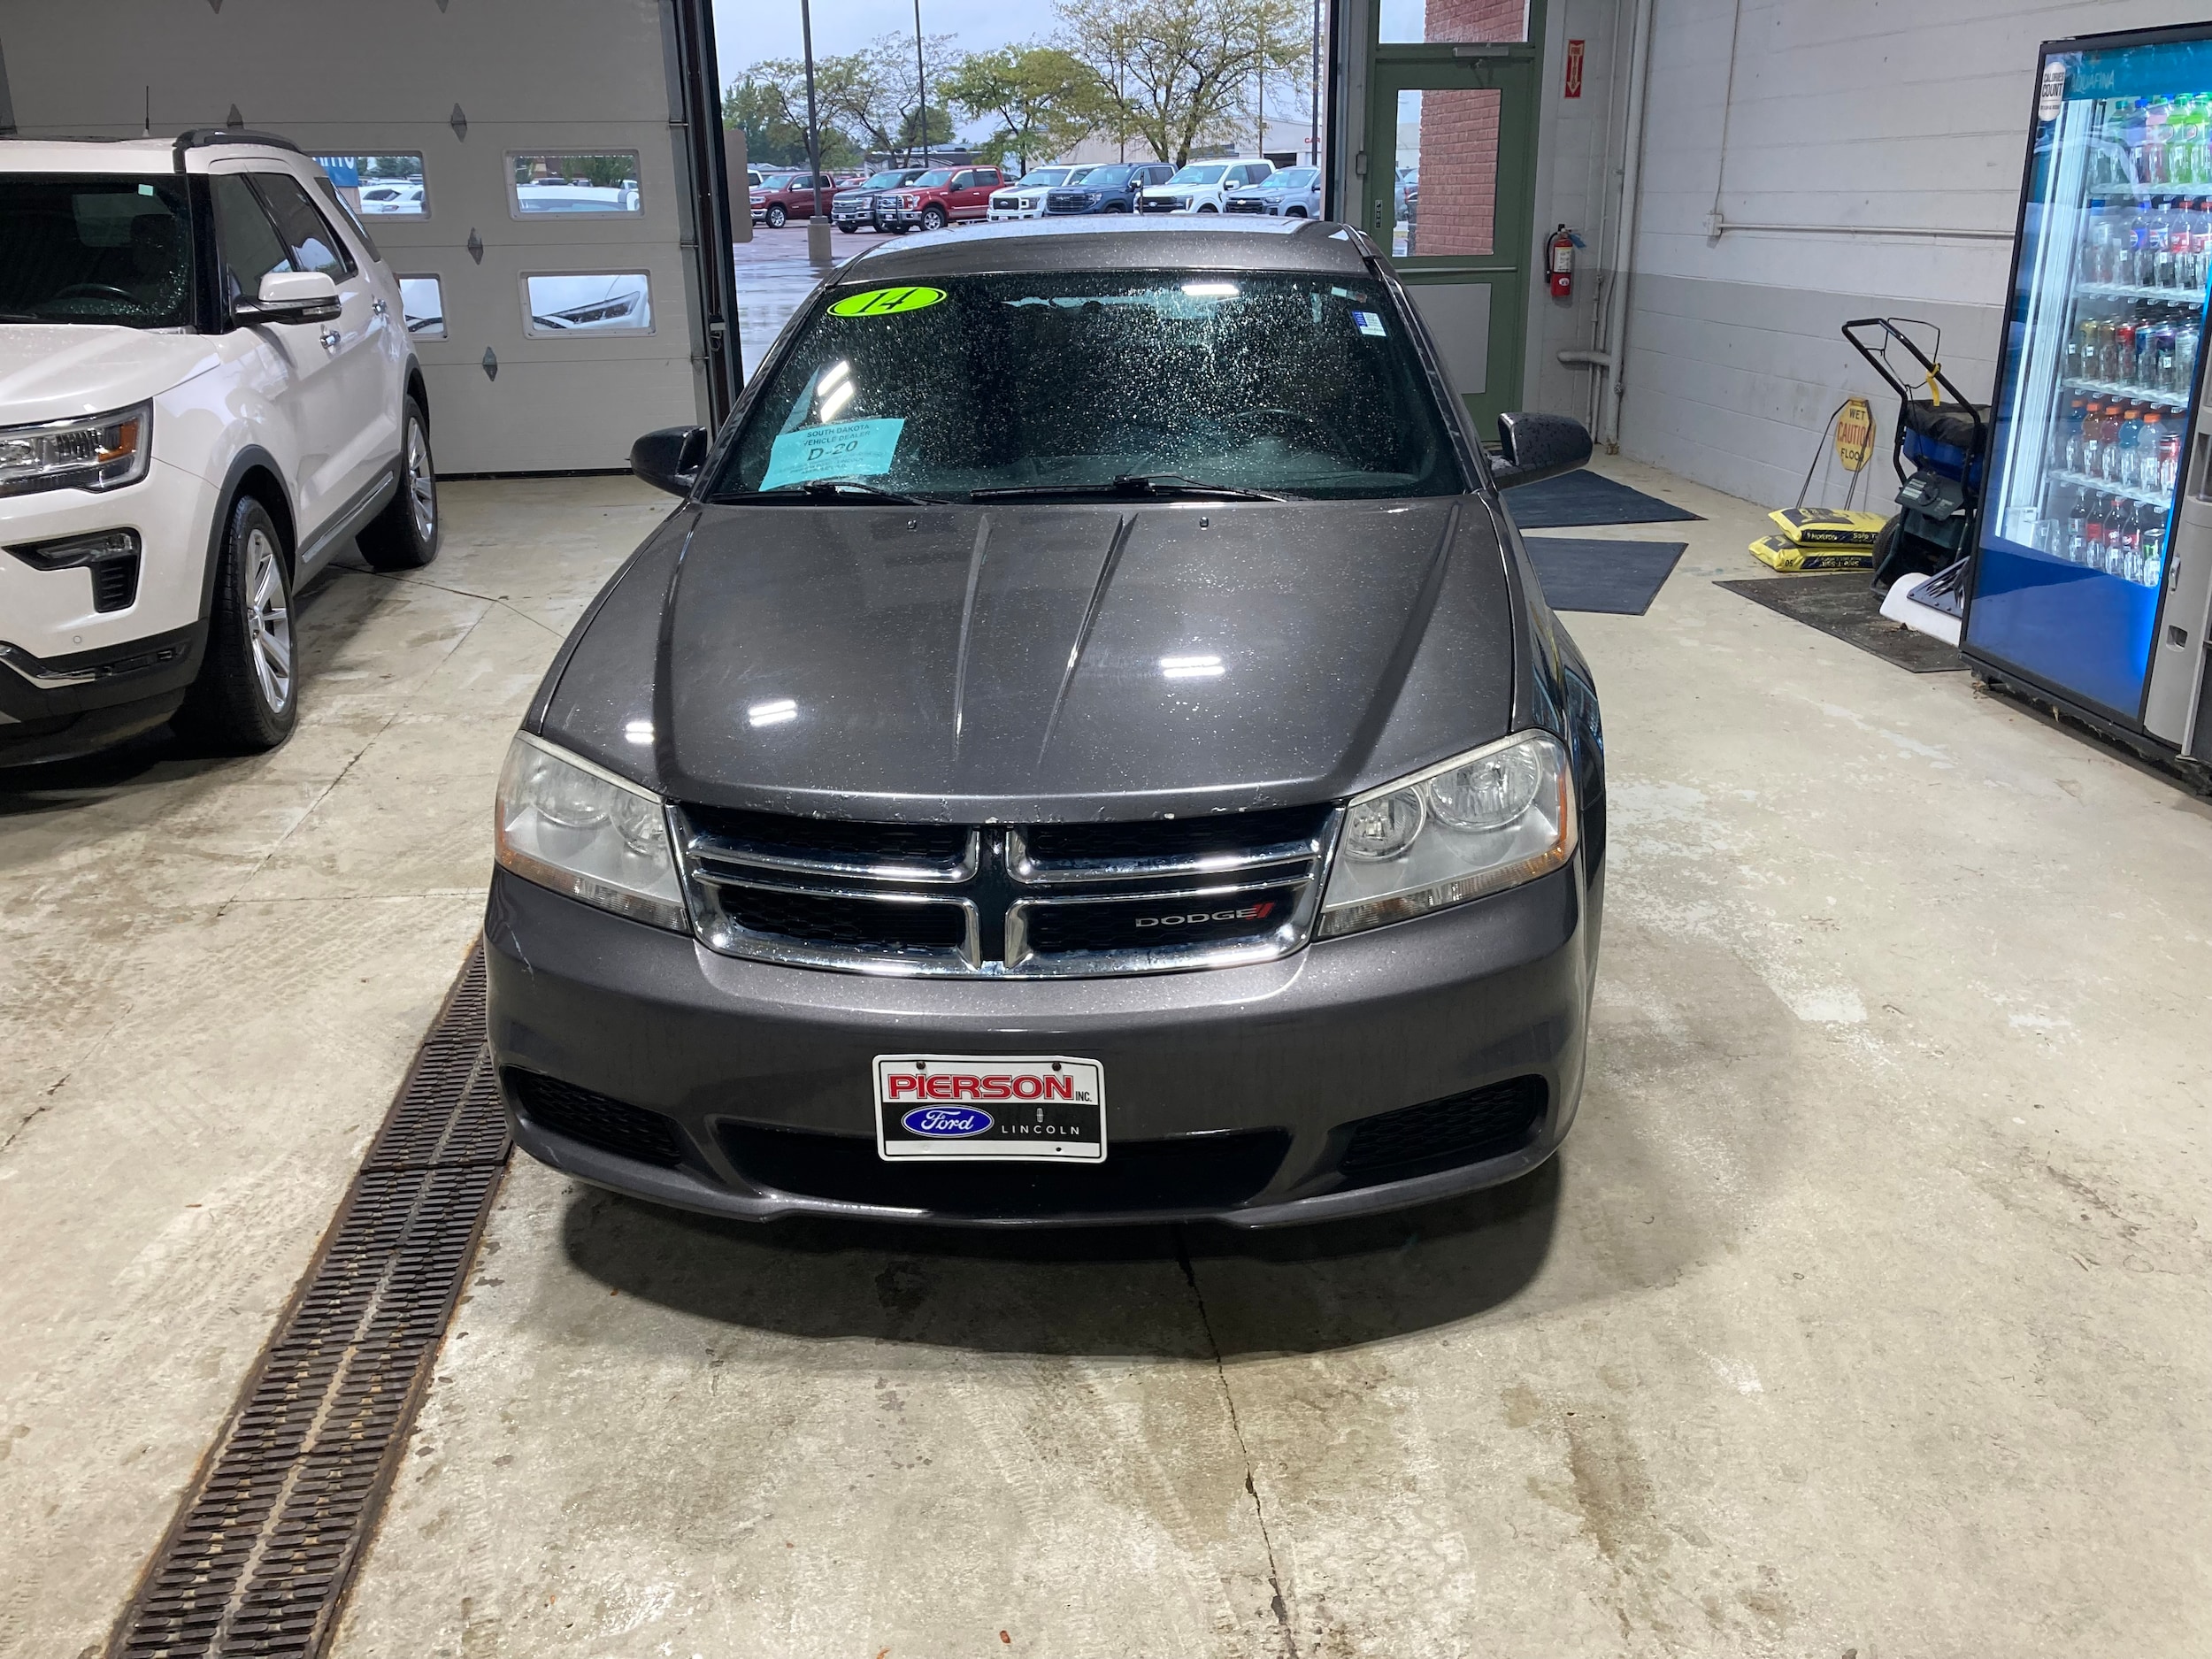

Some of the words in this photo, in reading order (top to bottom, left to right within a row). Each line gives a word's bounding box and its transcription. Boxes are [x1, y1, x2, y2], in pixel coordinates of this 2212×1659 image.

[2043, 72, 2065, 83] CALORIES
[2041, 83, 2063, 97] COUNT
[856, 288, 919, 313] 14
[1849, 408, 1866, 420] WET
[803, 436, 837, 447] VEHICLE
[838, 430, 871, 442] DEALER
[806, 427, 834, 438] SOUTH
[836, 424, 870, 434] DAKOTA
[806, 440, 858, 461] D-20
[1135, 907, 1257, 928] DODGE
[887, 1073, 1074, 1100] PIERSON
[1075, 1090, 1093, 1102] INC.
[920, 1109, 974, 1131] Ford
[1002, 1125, 1080, 1135] LINCOLN
